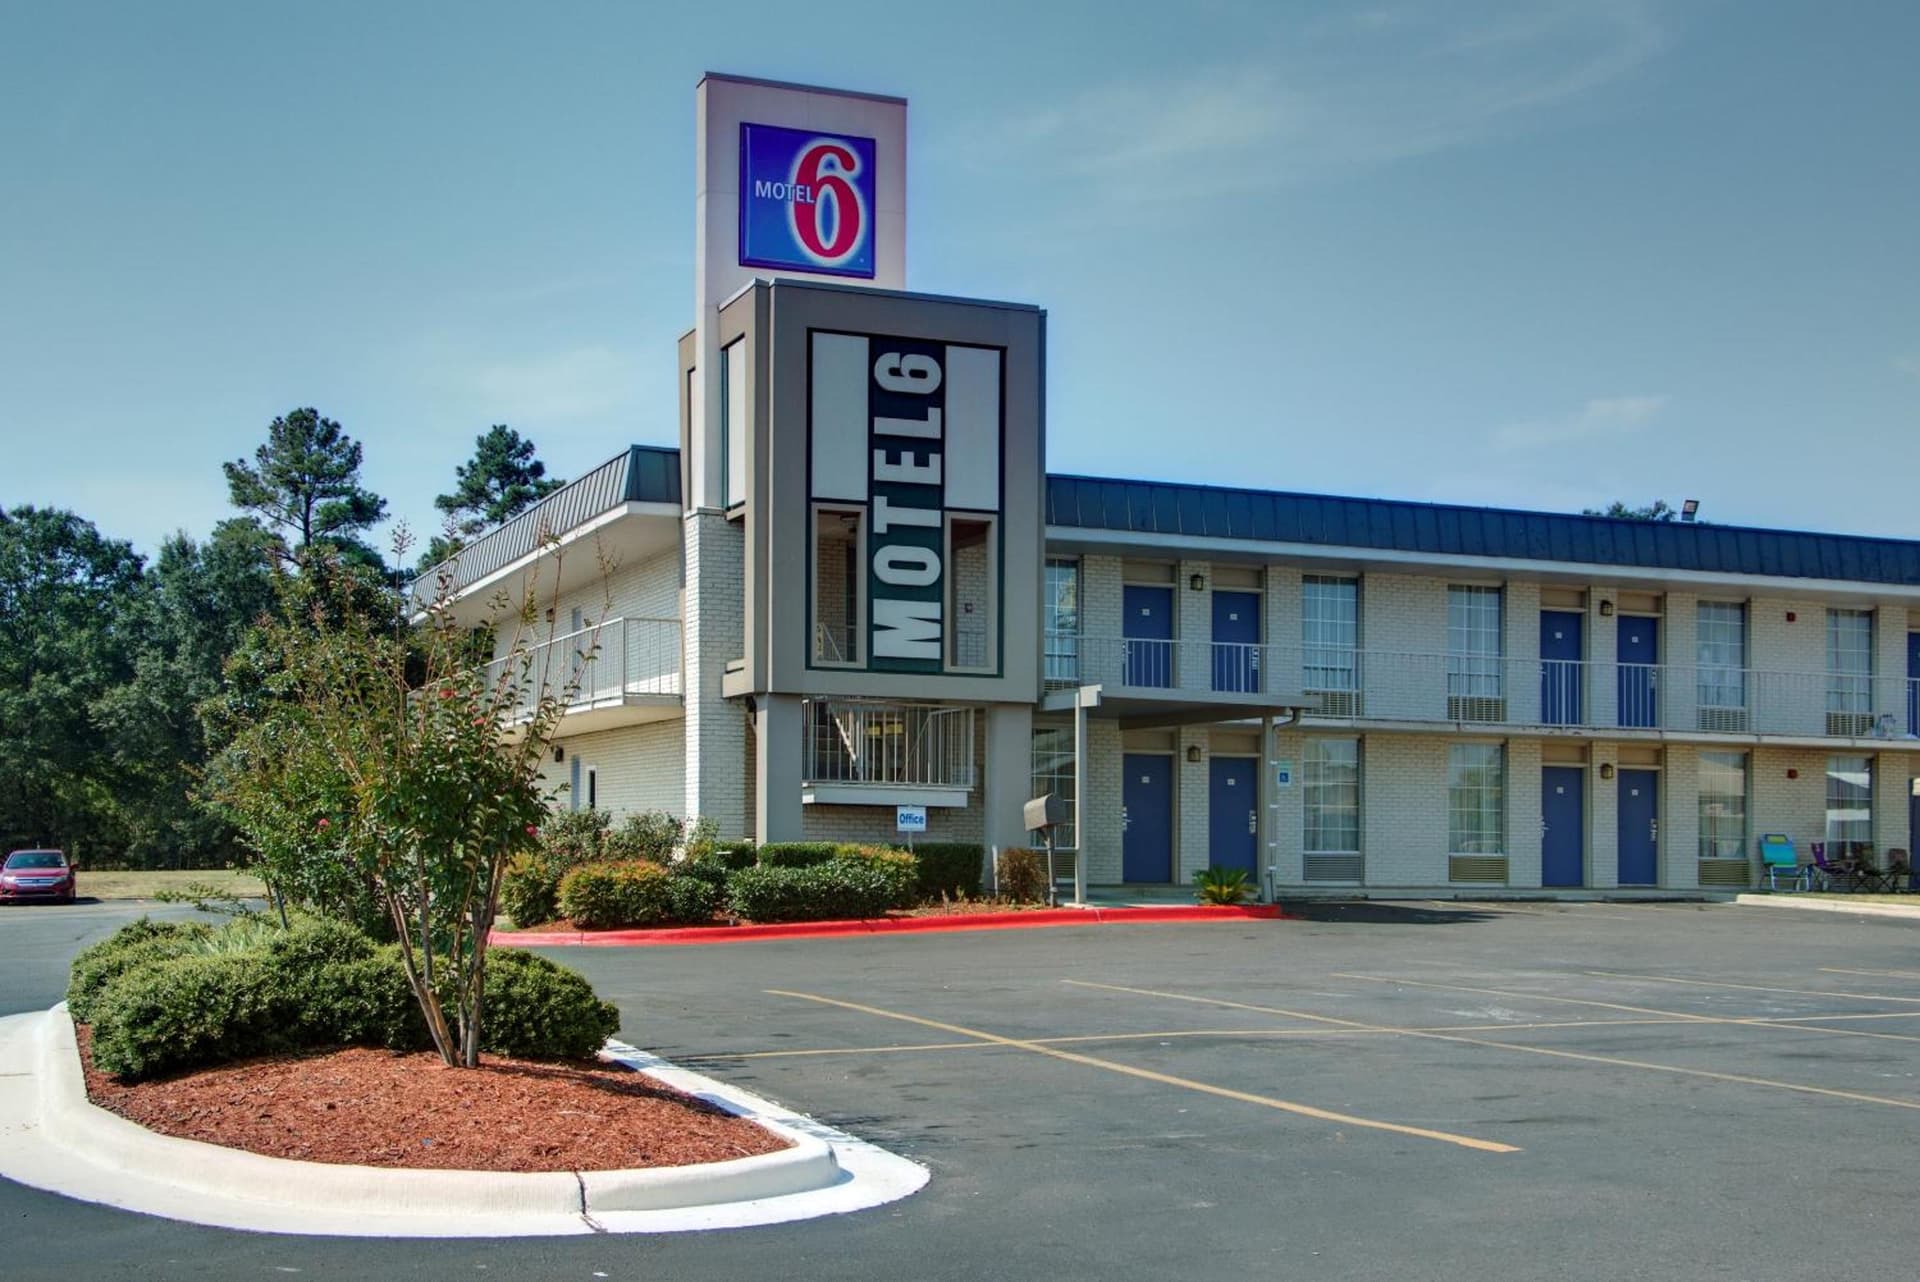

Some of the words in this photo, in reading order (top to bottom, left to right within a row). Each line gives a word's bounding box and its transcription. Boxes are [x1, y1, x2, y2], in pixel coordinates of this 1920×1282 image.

[755, 180, 815, 203] MOTEL
[792, 142, 863, 260] 6
[899, 813, 924, 825] Office
